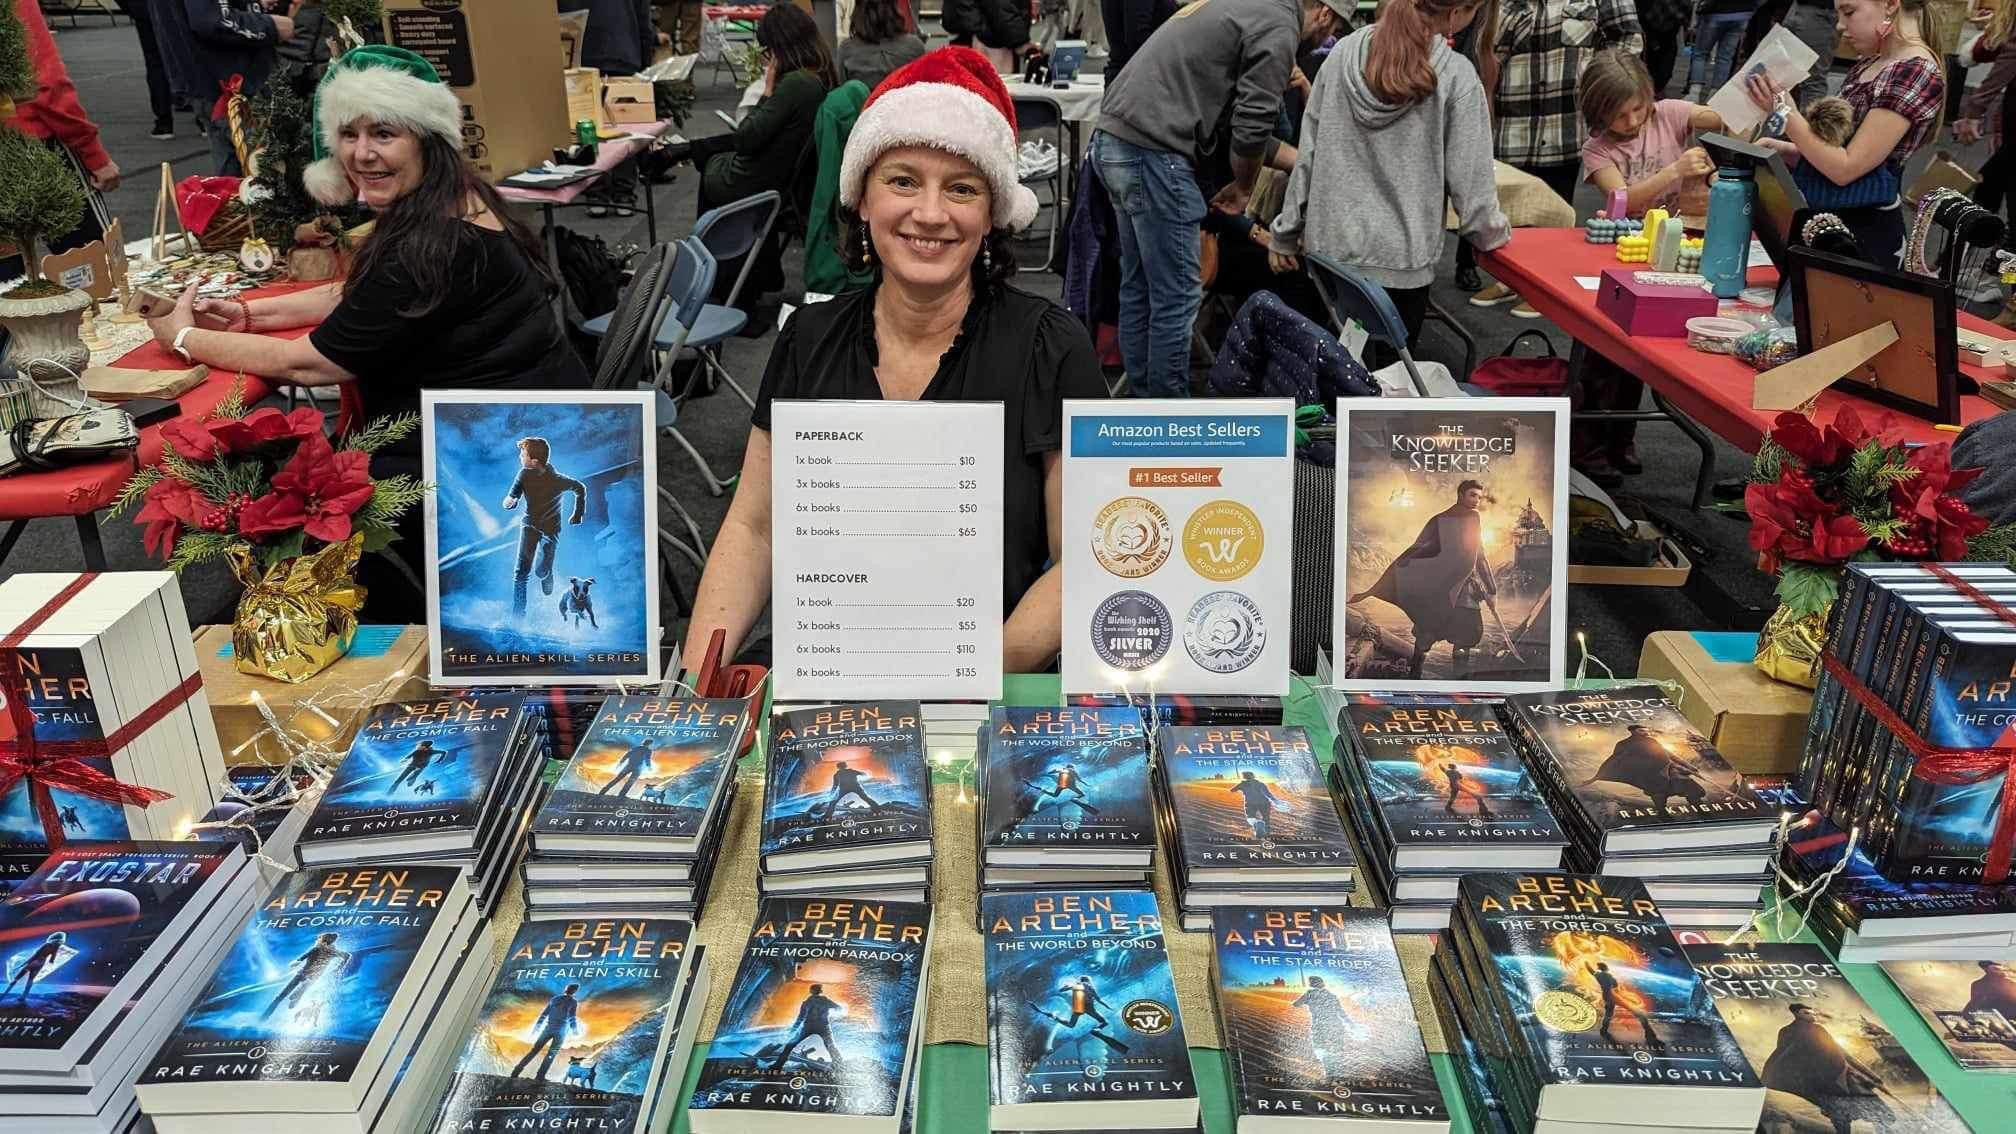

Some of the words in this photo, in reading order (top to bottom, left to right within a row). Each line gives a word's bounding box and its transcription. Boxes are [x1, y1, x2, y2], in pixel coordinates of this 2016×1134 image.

[1098, 424, 1163, 437] Amazon
[1169, 423, 1201, 437] Best
[1207, 422, 1260, 437] Sellers
[1439, 425, 1464, 435] THE
[795, 432, 864, 441] PAPERBACK
[1391, 435, 1513, 452] KNOWLEDGE
[796, 456, 805, 465] 1x
[808, 456, 832, 465] book
[959, 456, 975, 466] $10
[1410, 452, 1490, 472] SEEKER
[1136, 474, 1149, 483] #1
[1154, 473, 1178, 483] Best
[1181, 473, 1213, 483] Seller
[796, 480, 808, 489] 3x
[811, 480, 840, 489] books
[959, 480, 976, 490] $25
[796, 503, 808, 512] 6x
[811, 503, 840, 512] books
[959, 504, 977, 514] $50
[796, 527, 808, 536] 8x
[811, 527, 840, 536] books
[958, 527, 976, 537] $65
[1204, 528, 1244, 536] WINNER
[796, 574, 868, 583] HARDCOVER
[797, 598, 806, 607] 1x
[808, 598, 832, 607] book
[956, 598, 974, 608] $20
[797, 621, 809, 630] 3x
[811, 621, 840, 630] books
[958, 621, 976, 631] $55
[1108, 616, 1136, 625] Wishing
[1137, 628, 1160, 636] 2020
[796, 645, 809, 654] 6x
[811, 645, 841, 654] books
[956, 645, 975, 655] $110
[1110, 638, 1153, 650] SILVER
[450, 655, 477, 663] THE
[539, 654, 578, 662] SKILL
[588, 654, 640, 662] SERIES
[797, 668, 809, 677] 8x
[811, 668, 840, 677] books
[956, 668, 976, 678] $135
[411, 700, 480, 715] BEN
[643, 702, 709, 713] BEN
[1529, 698, 1678, 714] KNOWLEDGE
[52, 713, 94, 724] FALL
[366, 708, 511, 731] ARCHER
[600, 713, 739, 726] ARCHER
[816, 707, 880, 724] BEN
[1036, 712, 1098, 722] BEN
[1392, 709, 1458, 720] BEN
[1559, 710, 1655, 726] SEEKER
[1955, 713, 1987, 725] THE
[362, 734, 391, 742] THE
[396, 727, 457, 739] COSMIC
[463, 724, 497, 734] FALL
[779, 716, 916, 741] ARCHER
[1000, 724, 1136, 734] ARCHER
[1362, 720, 1501, 734] ARCHER
[1207, 730, 1272, 742] BEN
[1407, 737, 1459, 745] TOREO
[1464, 737, 1497, 745] SON
[779, 744, 802, 752] THE
[807, 739, 849, 749] MOON
[853, 734, 913, 744] PARADOX
[1175, 743, 1311, 754] ARCHER
[1619, 809, 1658, 819] RAE
[1666, 800, 1759, 815] KNIGHTLY
[313, 824, 352, 835] RAE
[363, 814, 460, 830] KNIGHTLY
[549, 818, 585, 826] RAE
[595, 819, 687, 828] KNIGHTLY
[778, 835, 814, 846] RAE
[826, 824, 918, 839] KNIGHTLY
[1048, 832, 1141, 840] KNIGHTLY
[1411, 829, 1447, 837] RAE
[1458, 829, 1550, 837] KNIGHTLY
[1250, 851, 1341, 859] KNIGHTLY
[46, 860, 201, 884] EXOSTAR
[1912, 865, 1947, 876] RAE
[322, 871, 410, 889] BEN
[1516, 877, 1605, 896] BEN
[265, 889, 446, 910] ARCHER
[1034, 896, 1112, 912] BEN
[804, 903, 885, 921] BEN
[1481, 895, 1661, 918] ARCHER
[1866, 903, 1902, 912] RAE
[256, 918, 289, 929] THE
[296, 915, 373, 927] COSMIC
[379, 916, 421, 927] FALL
[992, 913, 1162, 933] ARCHER
[1265, 912, 1345, 930] BEN
[564, 922, 647, 939] BEN
[755, 922, 923, 944] ARCHER
[1498, 921, 1536, 931] THE
[1544, 921, 1607, 933] TOREO
[1614, 923, 1657, 935] SON
[511, 941, 683, 961] ARCHER
[996, 942, 1025, 951] THE
[1030, 940, 1087, 950] WORLD
[1092, 939, 1157, 949] BEYOND
[751, 947, 779, 957] THE
[784, 948, 835, 958] MOON
[839, 950, 915, 962] PARADOX
[1723, 953, 1761, 962] THE
[1250, 956, 1280, 965] THE
[1286, 958, 1322, 967] STAR
[1328, 959, 1373, 969] RIDER
[516, 970, 549, 979] THE
[554, 968, 608, 978] ALIEN
[615, 968, 662, 978] SKILL
[1709, 980, 1819, 1001] SEEKER
[155, 1065, 204, 1078] RAE
[216, 1063, 341, 1075] KNIGHTLY
[1558, 1064, 1606, 1078] RAE
[1620, 1067, 1745, 1083] KNIGHTLY
[1068, 1081, 1184, 1093] KNIGHTLY
[707, 1092, 752, 1103] RAE
[1258, 1100, 1303, 1110] RAE
[1318, 1102, 1436, 1115] KNIGHTLY
[447, 1119, 492, 1130] RAE
[506, 1118, 626, 1129] KNIGHTLY
